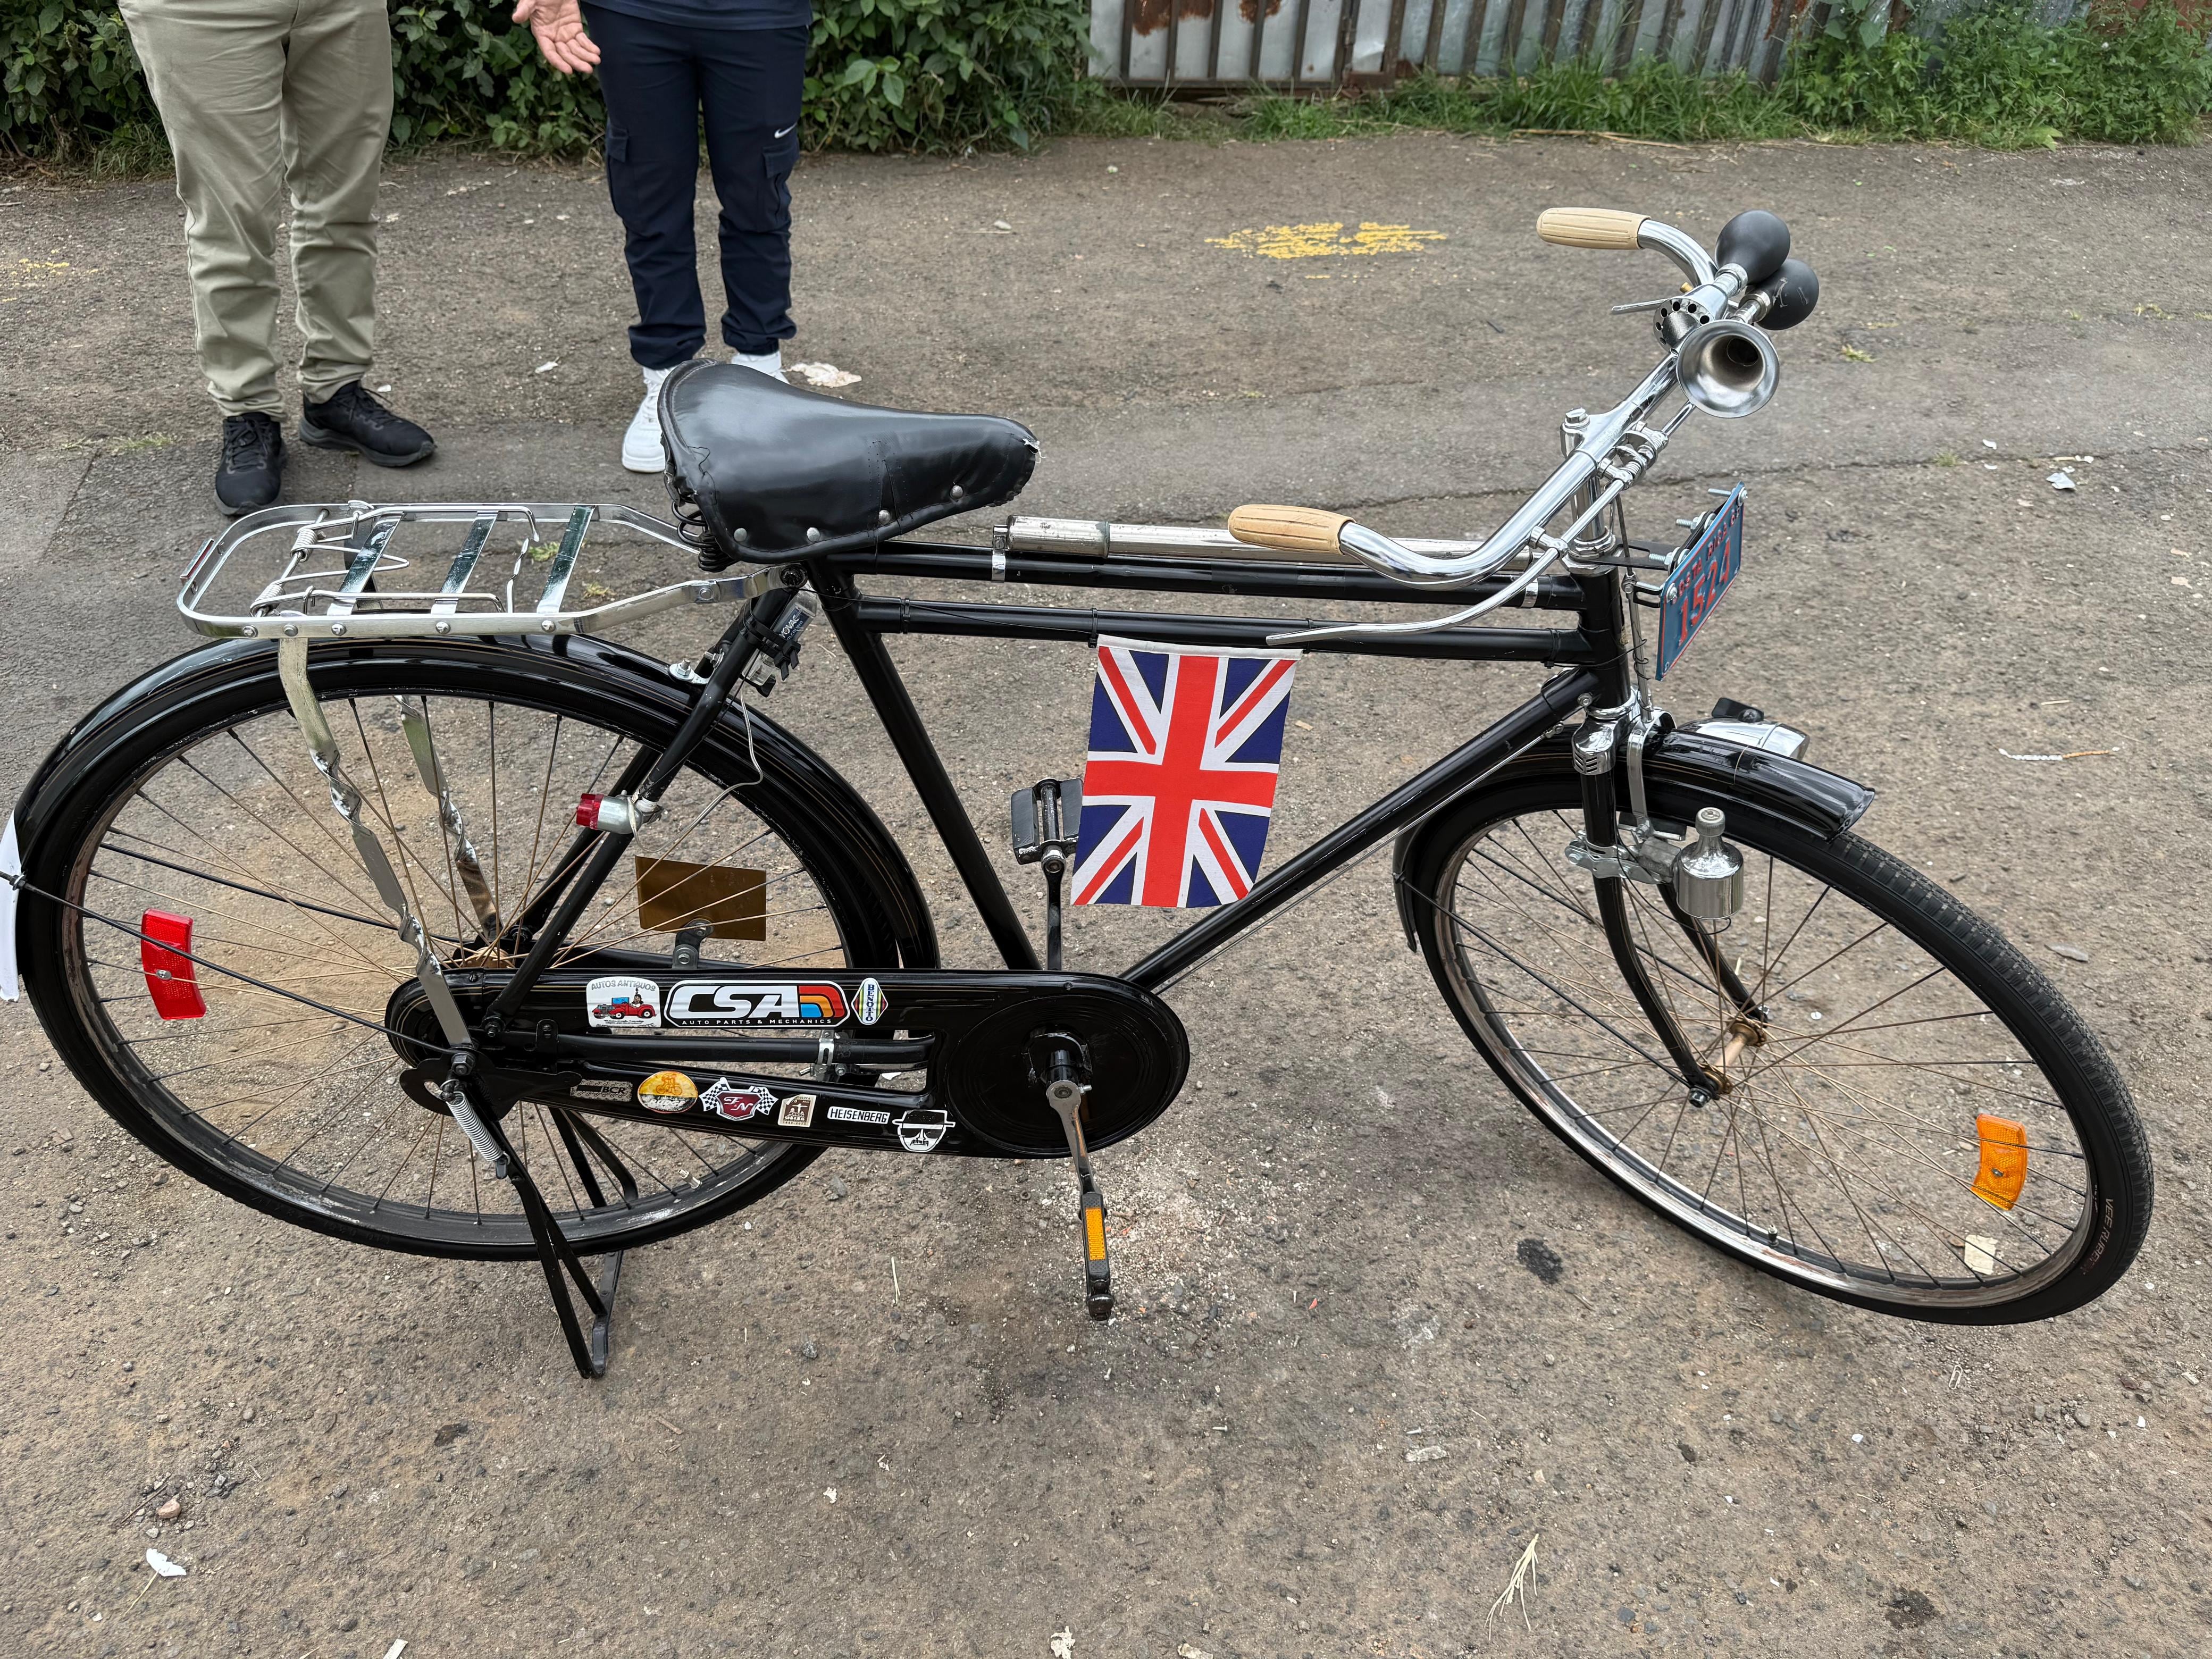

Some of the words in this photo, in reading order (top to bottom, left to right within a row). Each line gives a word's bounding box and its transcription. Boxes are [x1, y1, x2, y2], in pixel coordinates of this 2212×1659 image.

[1678, 537, 1731, 647] 1524
[778, 614, 800, 639] YOVAC
[591, 979, 617, 991] AUTOS
[669, 985, 800, 1019] CSA
[865, 984, 875, 1021] BENOTTO
[830, 1108, 889, 1123] HEISENBERG
[2104, 1198, 2114, 1228] VEE
